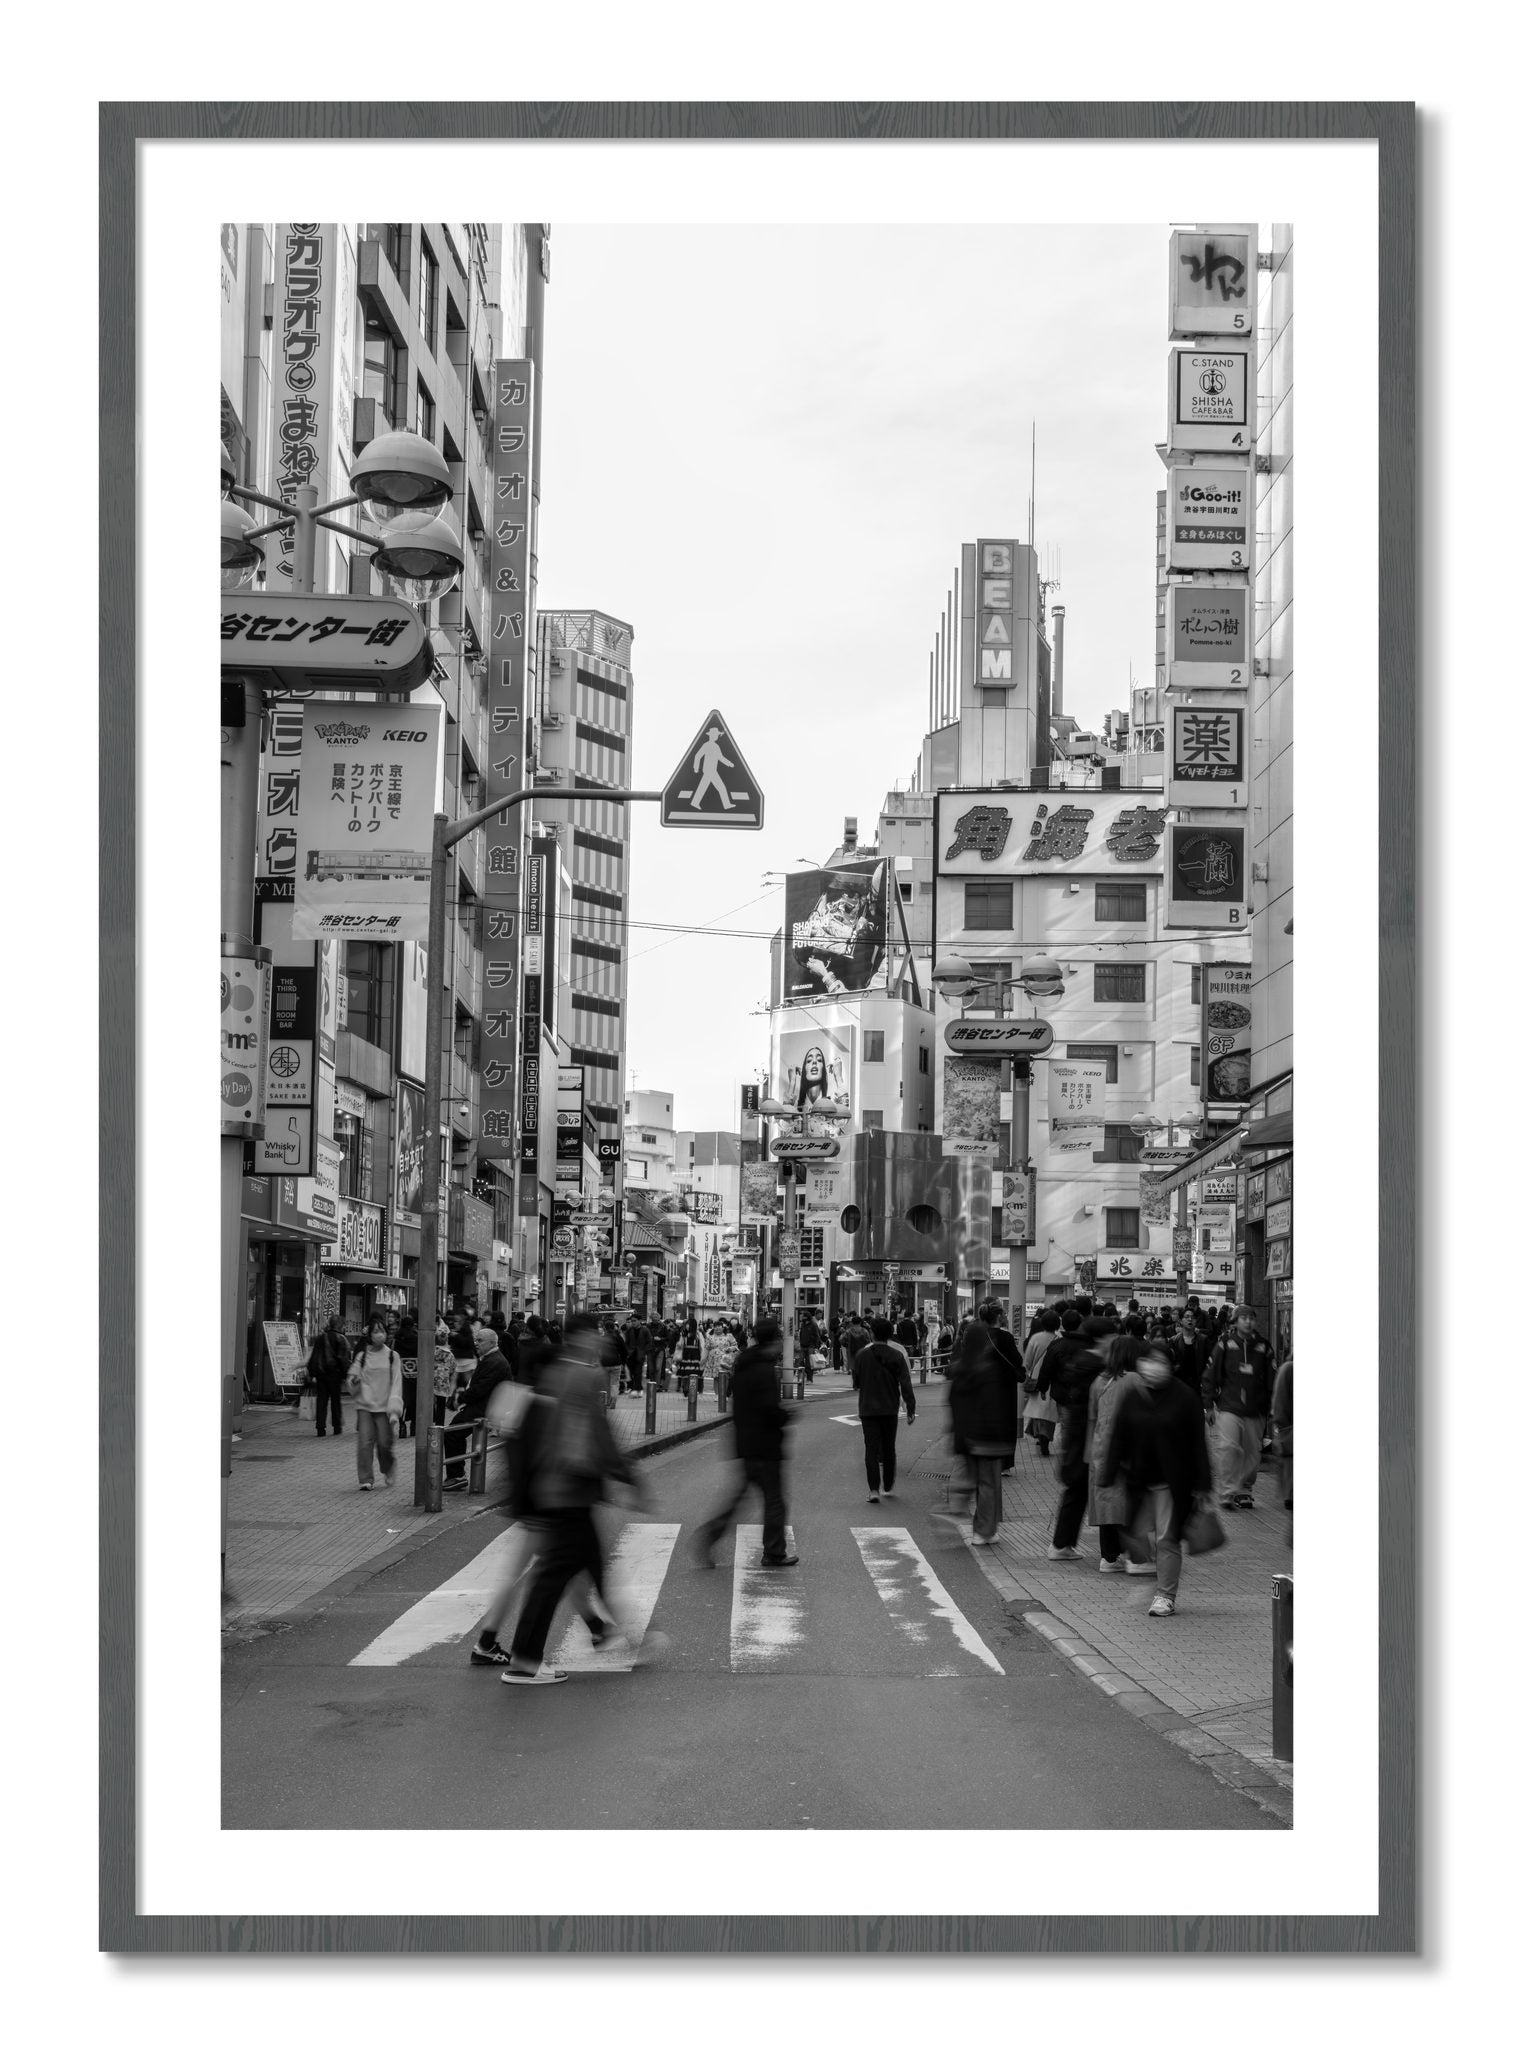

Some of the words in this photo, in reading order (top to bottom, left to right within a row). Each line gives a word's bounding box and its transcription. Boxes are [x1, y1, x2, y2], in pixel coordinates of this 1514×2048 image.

[283, 236, 323, 362] カラオケ
[1233, 314, 1245, 329] 5
[1191, 358, 1234, 368] C.STAND
[1192, 396, 1233, 407] SHISHA
[1232, 432, 1243, 447] 4
[1190, 487, 1241, 503] Goo-it!
[1184, 505, 1238, 515] 渋谷宇田川町店
[1179, 529, 1242, 540] 全身もみほぐし
[1231, 550, 1242, 566] 3
[982, 544, 1012, 679] BEAM
[1230, 669, 1241, 684] 2
[382, 729, 428, 743] KEIO
[1183, 714, 1231, 762] 薬
[331, 763, 346, 803] 冒険へ
[347, 763, 365, 833] カントーの
[387, 764, 403, 820] 京王線で
[1230, 789, 1238, 803] 1
[945, 804, 1168, 861] 角海老
[530, 860, 539, 893] kimono
[319, 914, 402, 927] 渋谷センター街
[529, 898, 539, 930] hearts
[1229, 908, 1240, 923] B
[951, 1027, 1047, 1040] 渋谷センター街
[232, 1080, 251, 1096] Day!
[265, 1142, 297, 1152] Whisky
[600, 1145, 619, 1155] GU
[264, 1151, 283, 1159] Bank
[1109, 1256, 1165, 1277] 兆楽
[711, 1255, 719, 1294] BEER
